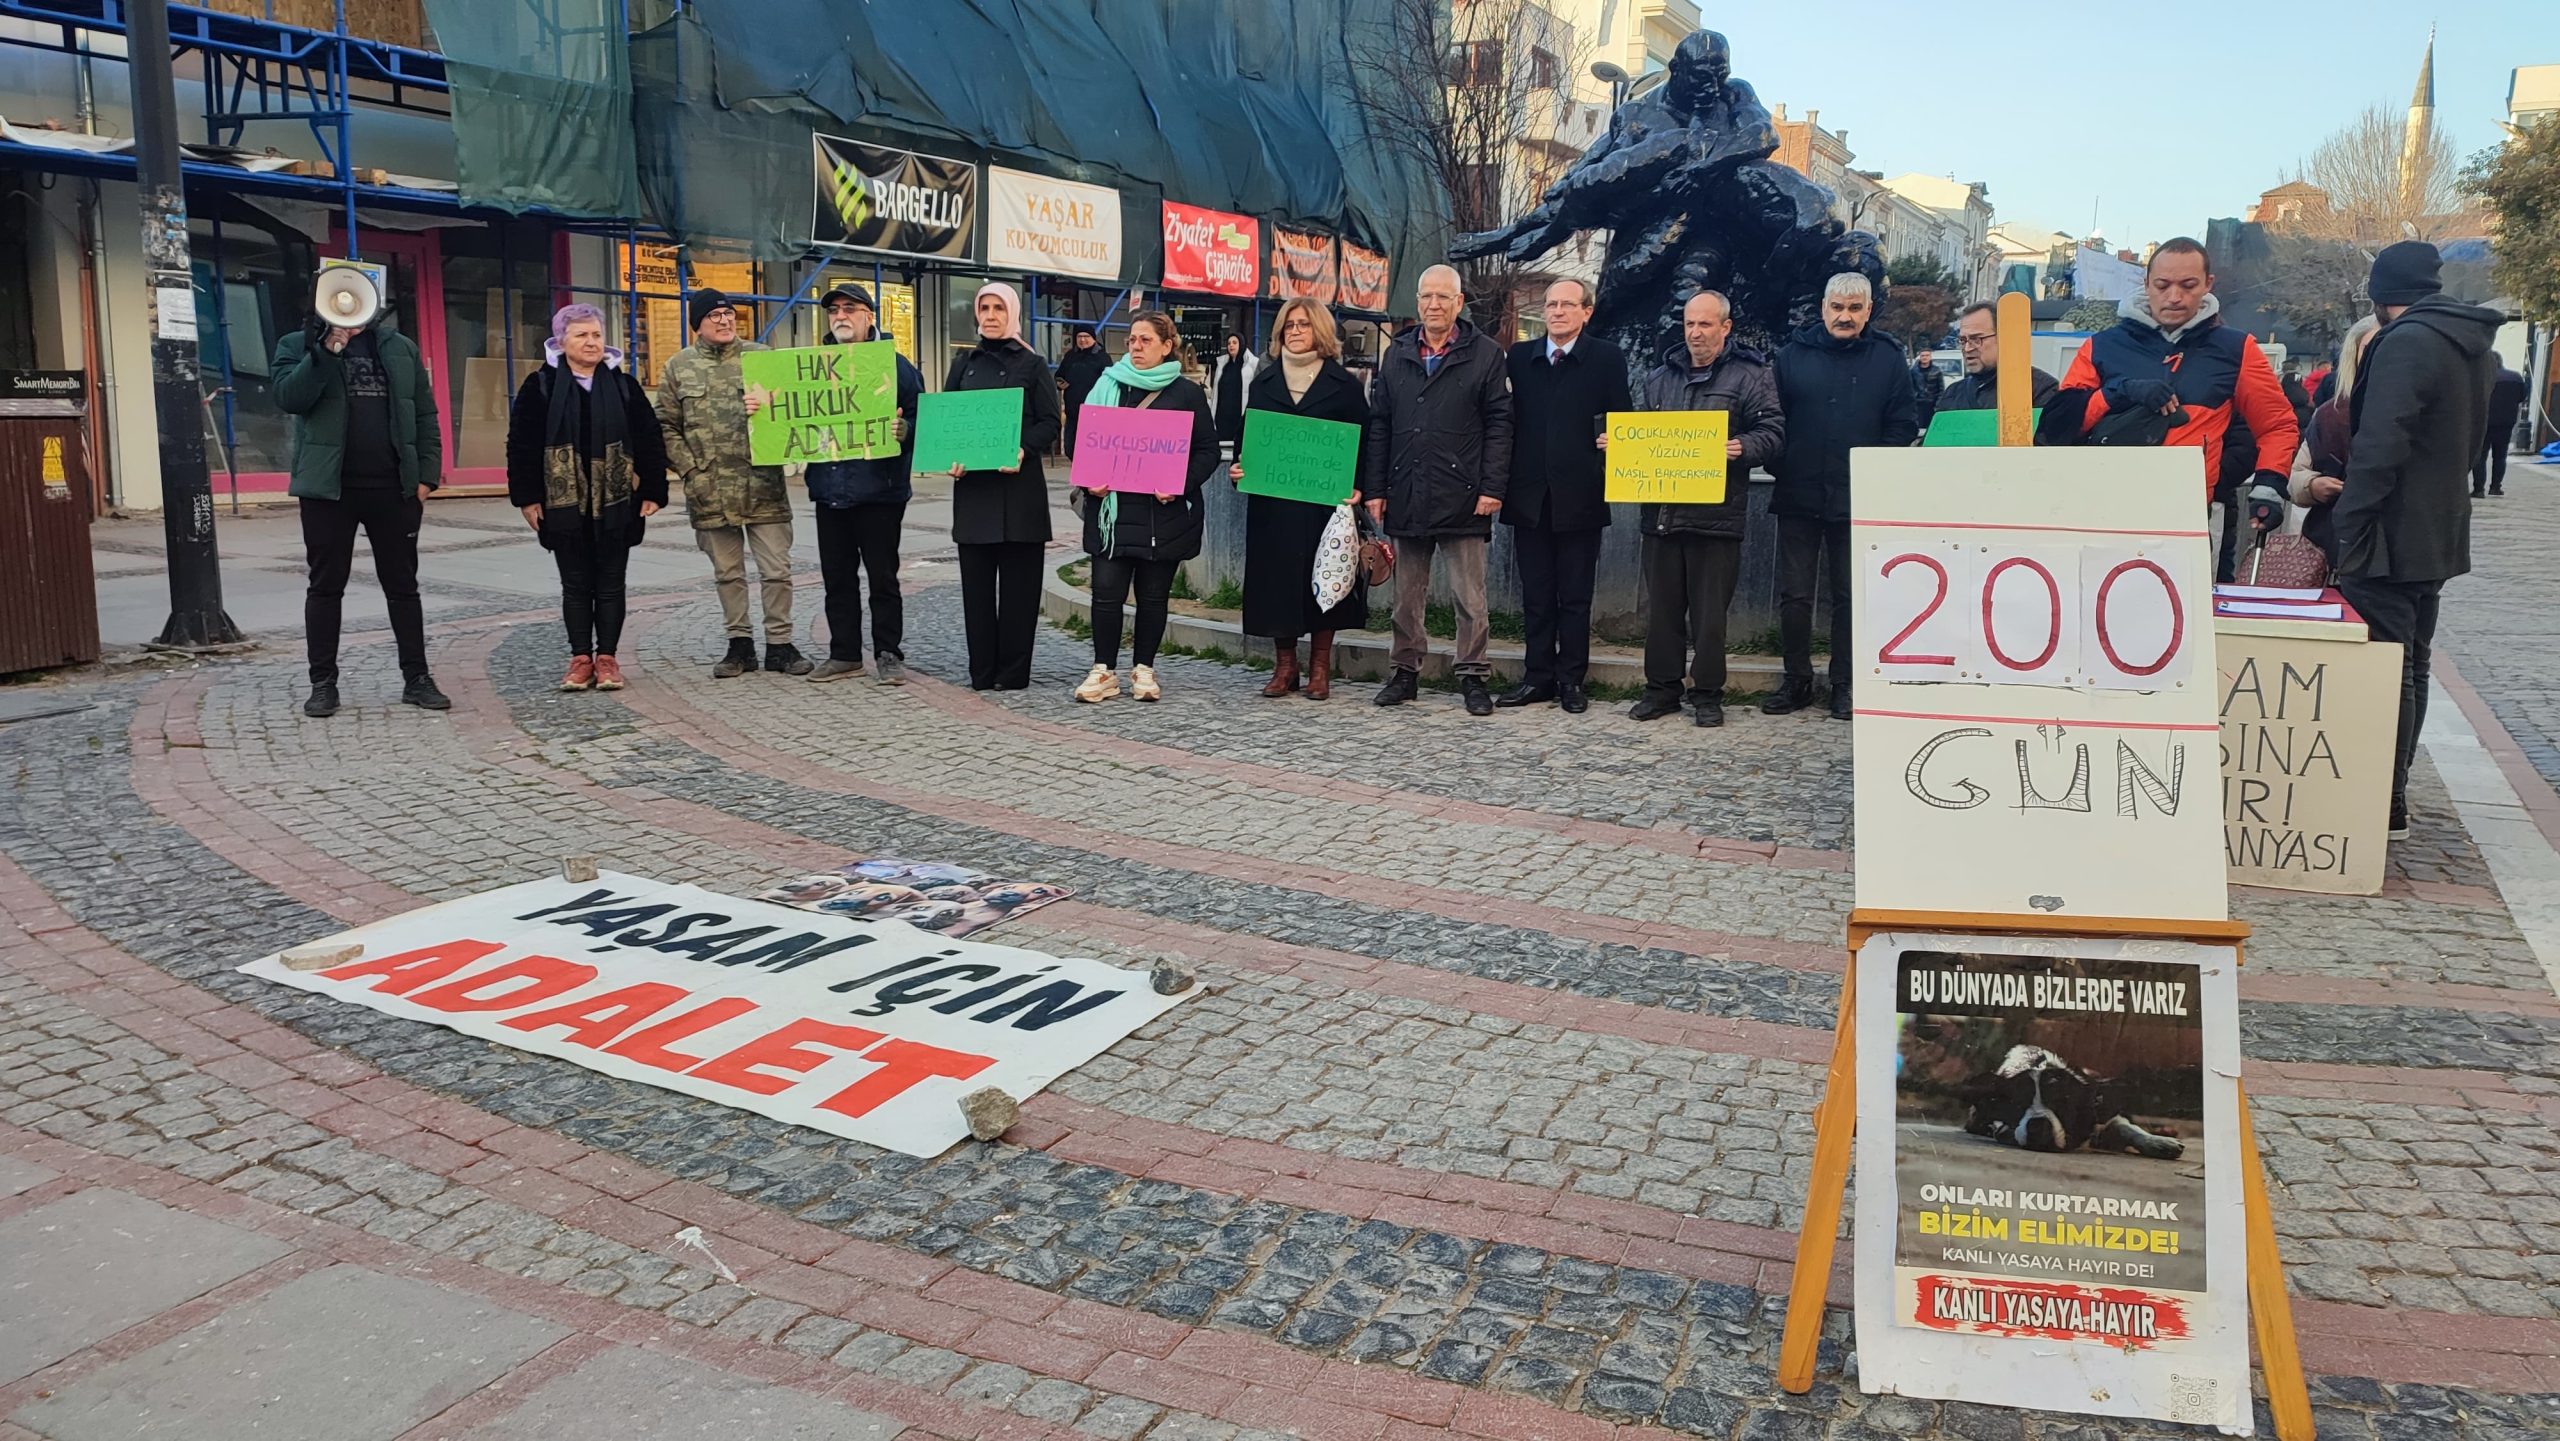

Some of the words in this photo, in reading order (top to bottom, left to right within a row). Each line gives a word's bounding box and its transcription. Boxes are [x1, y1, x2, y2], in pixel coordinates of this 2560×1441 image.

[873, 179, 963, 229] BARGELLO
[1025, 192, 1095, 231] YAŞAR
[1006, 228, 1109, 262] KUYUMCULUK
[1165, 212, 1215, 252] Ziyafet
[1205, 251, 1253, 287] Çiğköfte
[796, 353, 844, 381] HAK
[769, 384, 862, 422] HUKUK
[783, 415, 891, 459] ADALET
[1648, 443, 1701, 458] YÜZÜNE
[1878, 552, 2185, 676] 200
[1904, 717, 2185, 820] GÜN
[513, 888, 878, 974] YAŞAM
[827, 949, 1128, 1031] İÇİN
[1910, 969, 1935, 1002] BU
[1940, 964, 2029, 1008] DÜNYADA
[2033, 967, 2126, 1013] BİZLERDE
[2129, 979, 2188, 1016] VARIZ
[314, 938, 1001, 1119] ADALET
[1920, 1184, 2013, 1209] ONLARI
[2019, 1191, 2179, 1221] KURTARMAK
[1919, 1205, 2008, 1241] BİZİM
[2018, 1215, 2179, 1255] ELİMİZDE!
[1942, 1247, 1994, 1265] KANLI
[1997, 1252, 2064, 1272] YASAYA
[2068, 1258, 2121, 1277] HAYIR
[2125, 1263, 2155, 1279] DE!
[1933, 1286, 1998, 1324] KANLI
[2003, 1292, 2085, 1332] YASAYA
[2089, 1301, 2158, 1339] HAYIR
